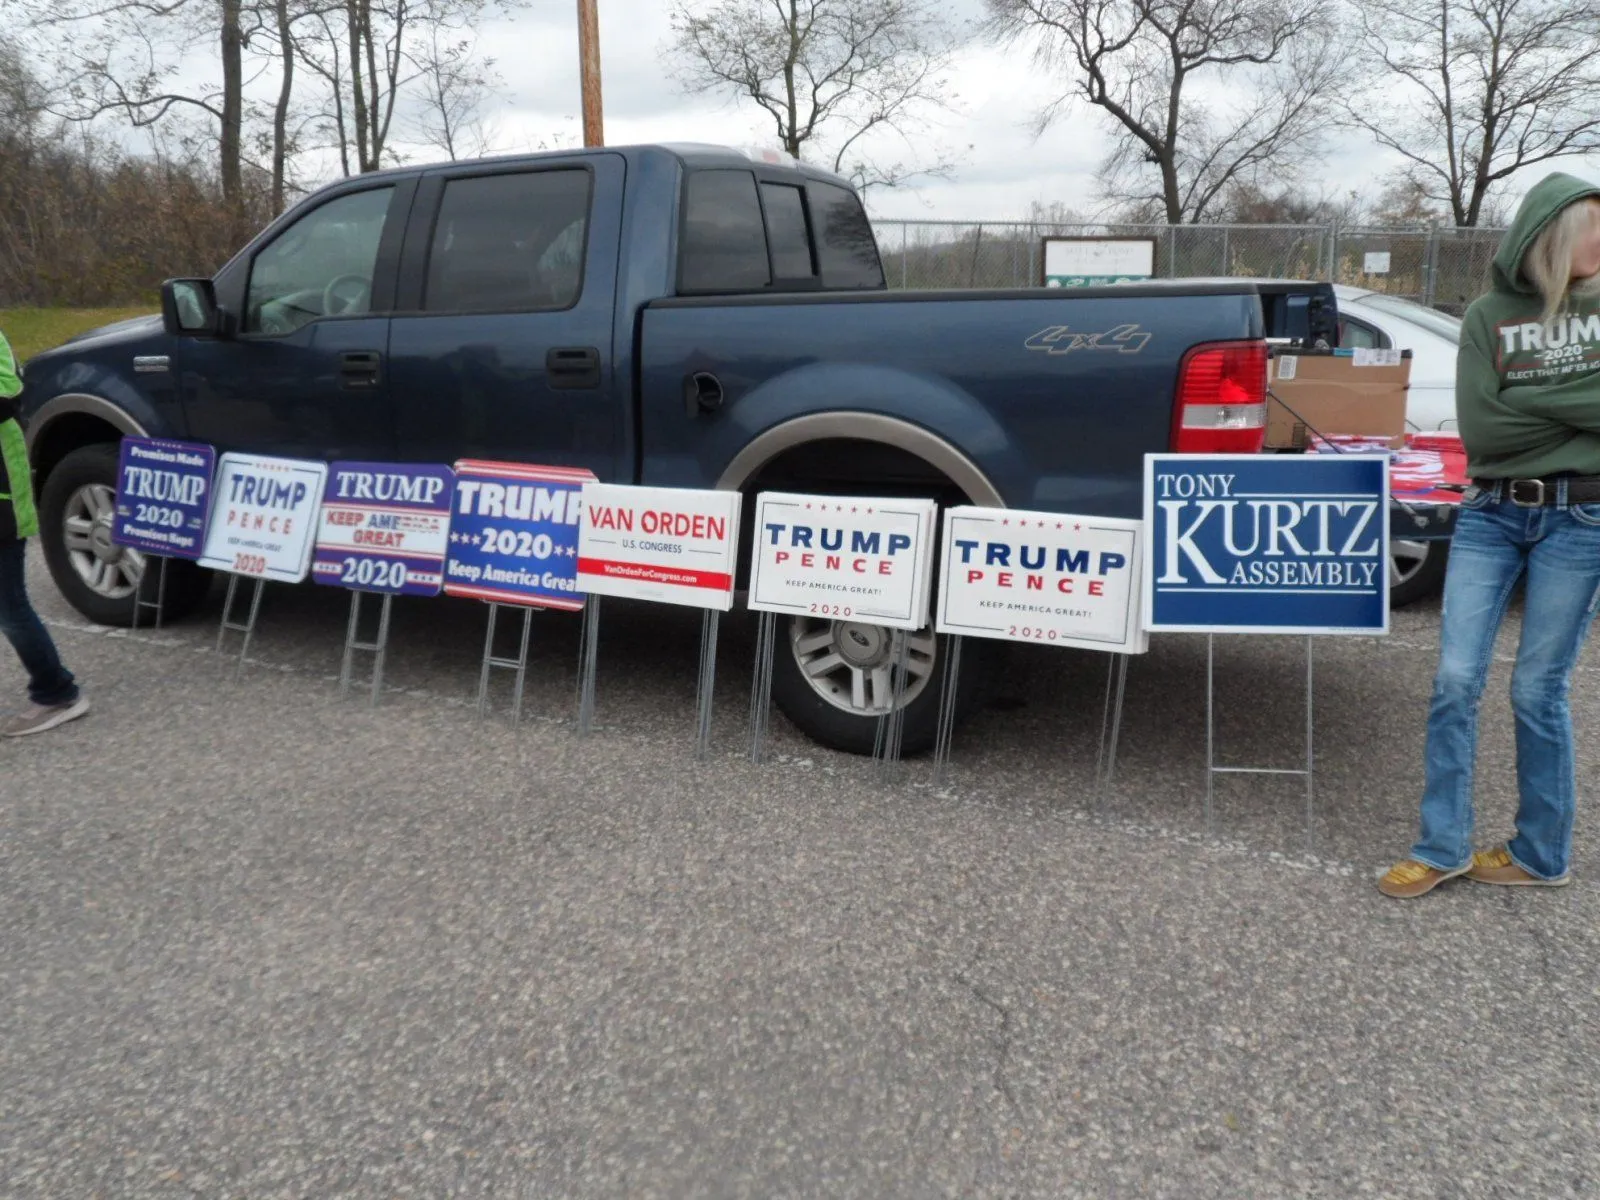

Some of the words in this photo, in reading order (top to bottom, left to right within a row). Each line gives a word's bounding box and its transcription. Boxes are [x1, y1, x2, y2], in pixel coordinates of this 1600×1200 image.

[1024, 324, 1152, 355] 4x4
[1499, 314, 1600, 353] TRUM
[1544, 344, 1582, 360] 2020
[1536, 367, 1559, 377] THAT
[131, 446, 175, 462] Promises
[177, 452, 205, 467] Made
[124, 465, 205, 506] TRUMP
[231, 473, 306, 511] TRUMP
[337, 471, 443, 503] TRUMP
[1158, 473, 1236, 497] TONY
[456, 480, 582, 526] TRUMP
[135, 504, 184, 528] 2020
[227, 510, 292, 535] PENCE
[327, 511, 364, 526] KEEP
[589, 505, 633, 531] VAN
[641, 510, 725, 541] ORDEN
[353, 529, 405, 547] GREAT
[480, 527, 553, 560] 2020
[622, 539, 637, 549] U.S.
[640, 541, 682, 554] CONGRESS
[766, 523, 911, 556] TRUMP
[1156, 500, 1379, 584] KURTZ
[233, 552, 266, 573] 2020
[775, 551, 893, 576] PENCE
[955, 540, 1125, 576] TRUMP
[341, 557, 407, 588] 2020
[448, 559, 481, 582] Keep
[482, 564, 539, 587] America
[542, 571, 576, 592] Grea
[604, 564, 697, 583] VanOrdenForCongress.com
[968, 570, 1105, 597] PENCE
[1229, 561, 1378, 586] ASSEMBLY
[809, 582, 847, 592] AMERICA
[850, 586, 882, 595] GREAT!
[810, 603, 852, 617] 2020
[979, 600, 1004, 609] KEEP
[1007, 603, 1051, 613] AMERICA
[1055, 609, 1092, 618] GREAT!
[1009, 626, 1057, 640] 2020
